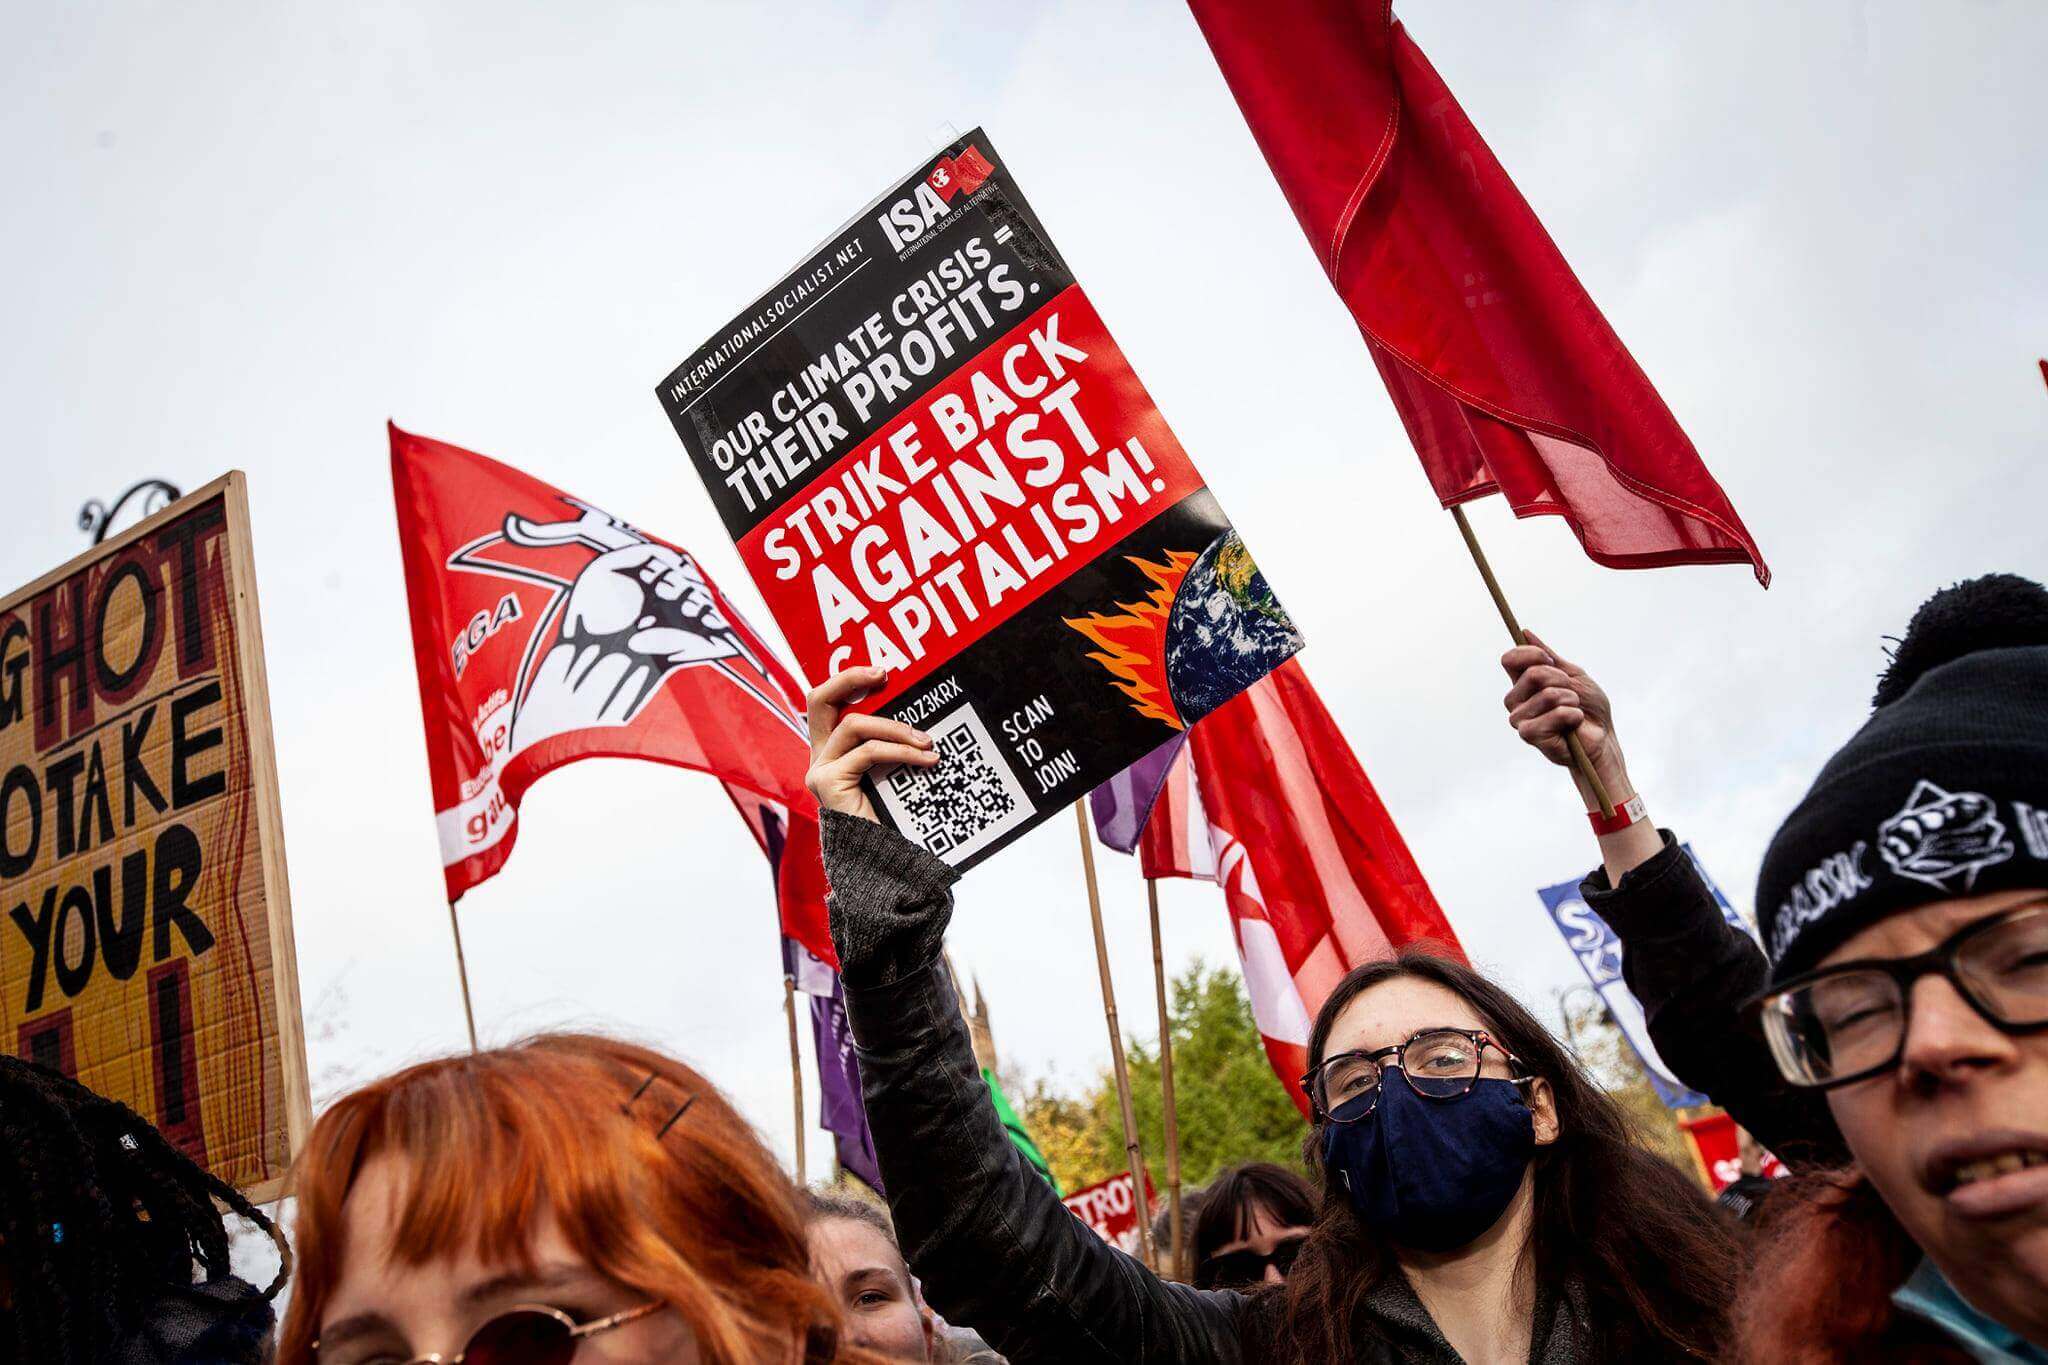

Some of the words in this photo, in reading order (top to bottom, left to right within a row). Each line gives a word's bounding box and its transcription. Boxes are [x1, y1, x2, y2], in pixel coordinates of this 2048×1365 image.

[878, 181, 951, 253] ISA
[899, 228, 938, 262] INTERNATIONAL
[937, 208, 965, 232] SOCIALIST
[963, 181, 1000, 214] ALTERNATIVE
[670, 238, 864, 402] INTERNATIONALSOCIALIST.NET
[712, 410, 774, 473] OUR
[771, 312, 894, 423] CLIMATE
[892, 237, 992, 330] CRISIS
[993, 224, 1014, 245] =
[725, 407, 849, 514] THEIR
[842, 262, 1041, 424] PROFITS.
[763, 420, 939, 581] STRIKE
[928, 313, 1089, 453] BACK
[812, 380, 1101, 644] AGAINST
[31, 494, 228, 753] HOT
[451, 591, 524, 683] EGA
[828, 436, 1166, 704] CAPITALISM!
[46, 680, 226, 860] TAKE
[1002, 694, 1055, 742] SCAN
[1015, 738, 1044, 768] TO
[1034, 748, 1081, 795] JOIN!
[9, 823, 215, 1015] YOUR
